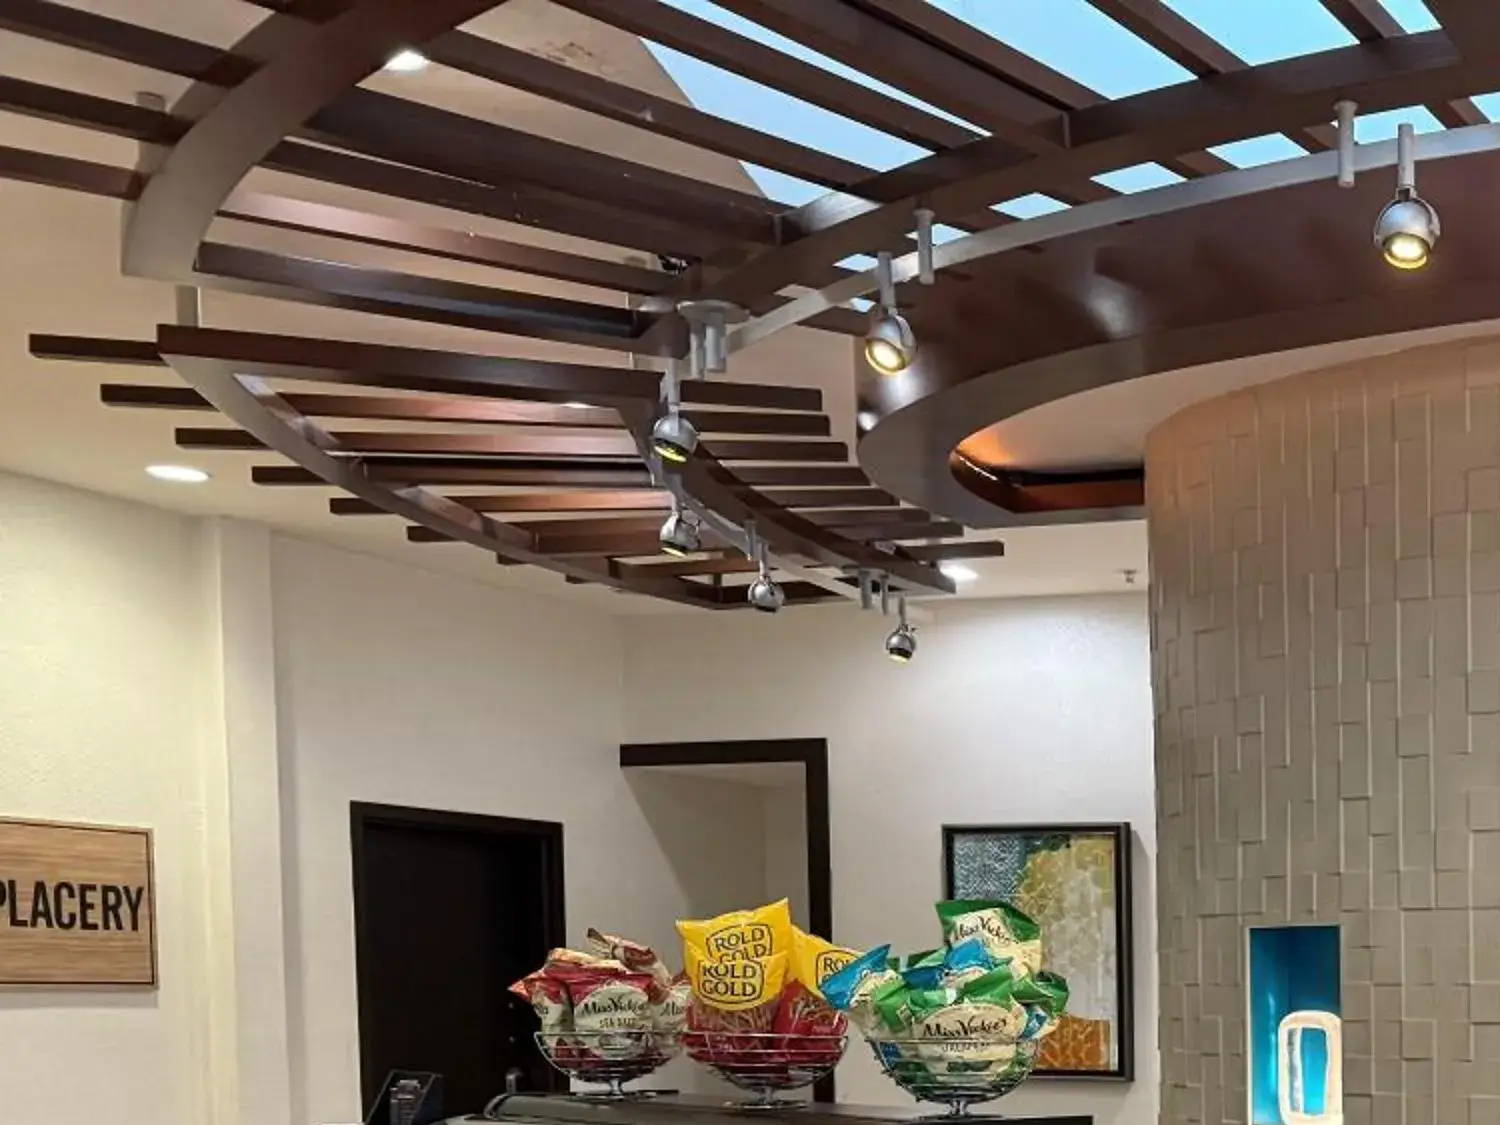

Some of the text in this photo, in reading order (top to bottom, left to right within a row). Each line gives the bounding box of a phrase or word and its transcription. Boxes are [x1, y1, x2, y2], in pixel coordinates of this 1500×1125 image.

[714, 927, 765, 952] ROLD
[702, 963, 757, 980] ROLD
[823, 957, 853, 971] RO
[701, 980, 757, 997] GOLD
[922, 1022, 962, 1038] Miss
